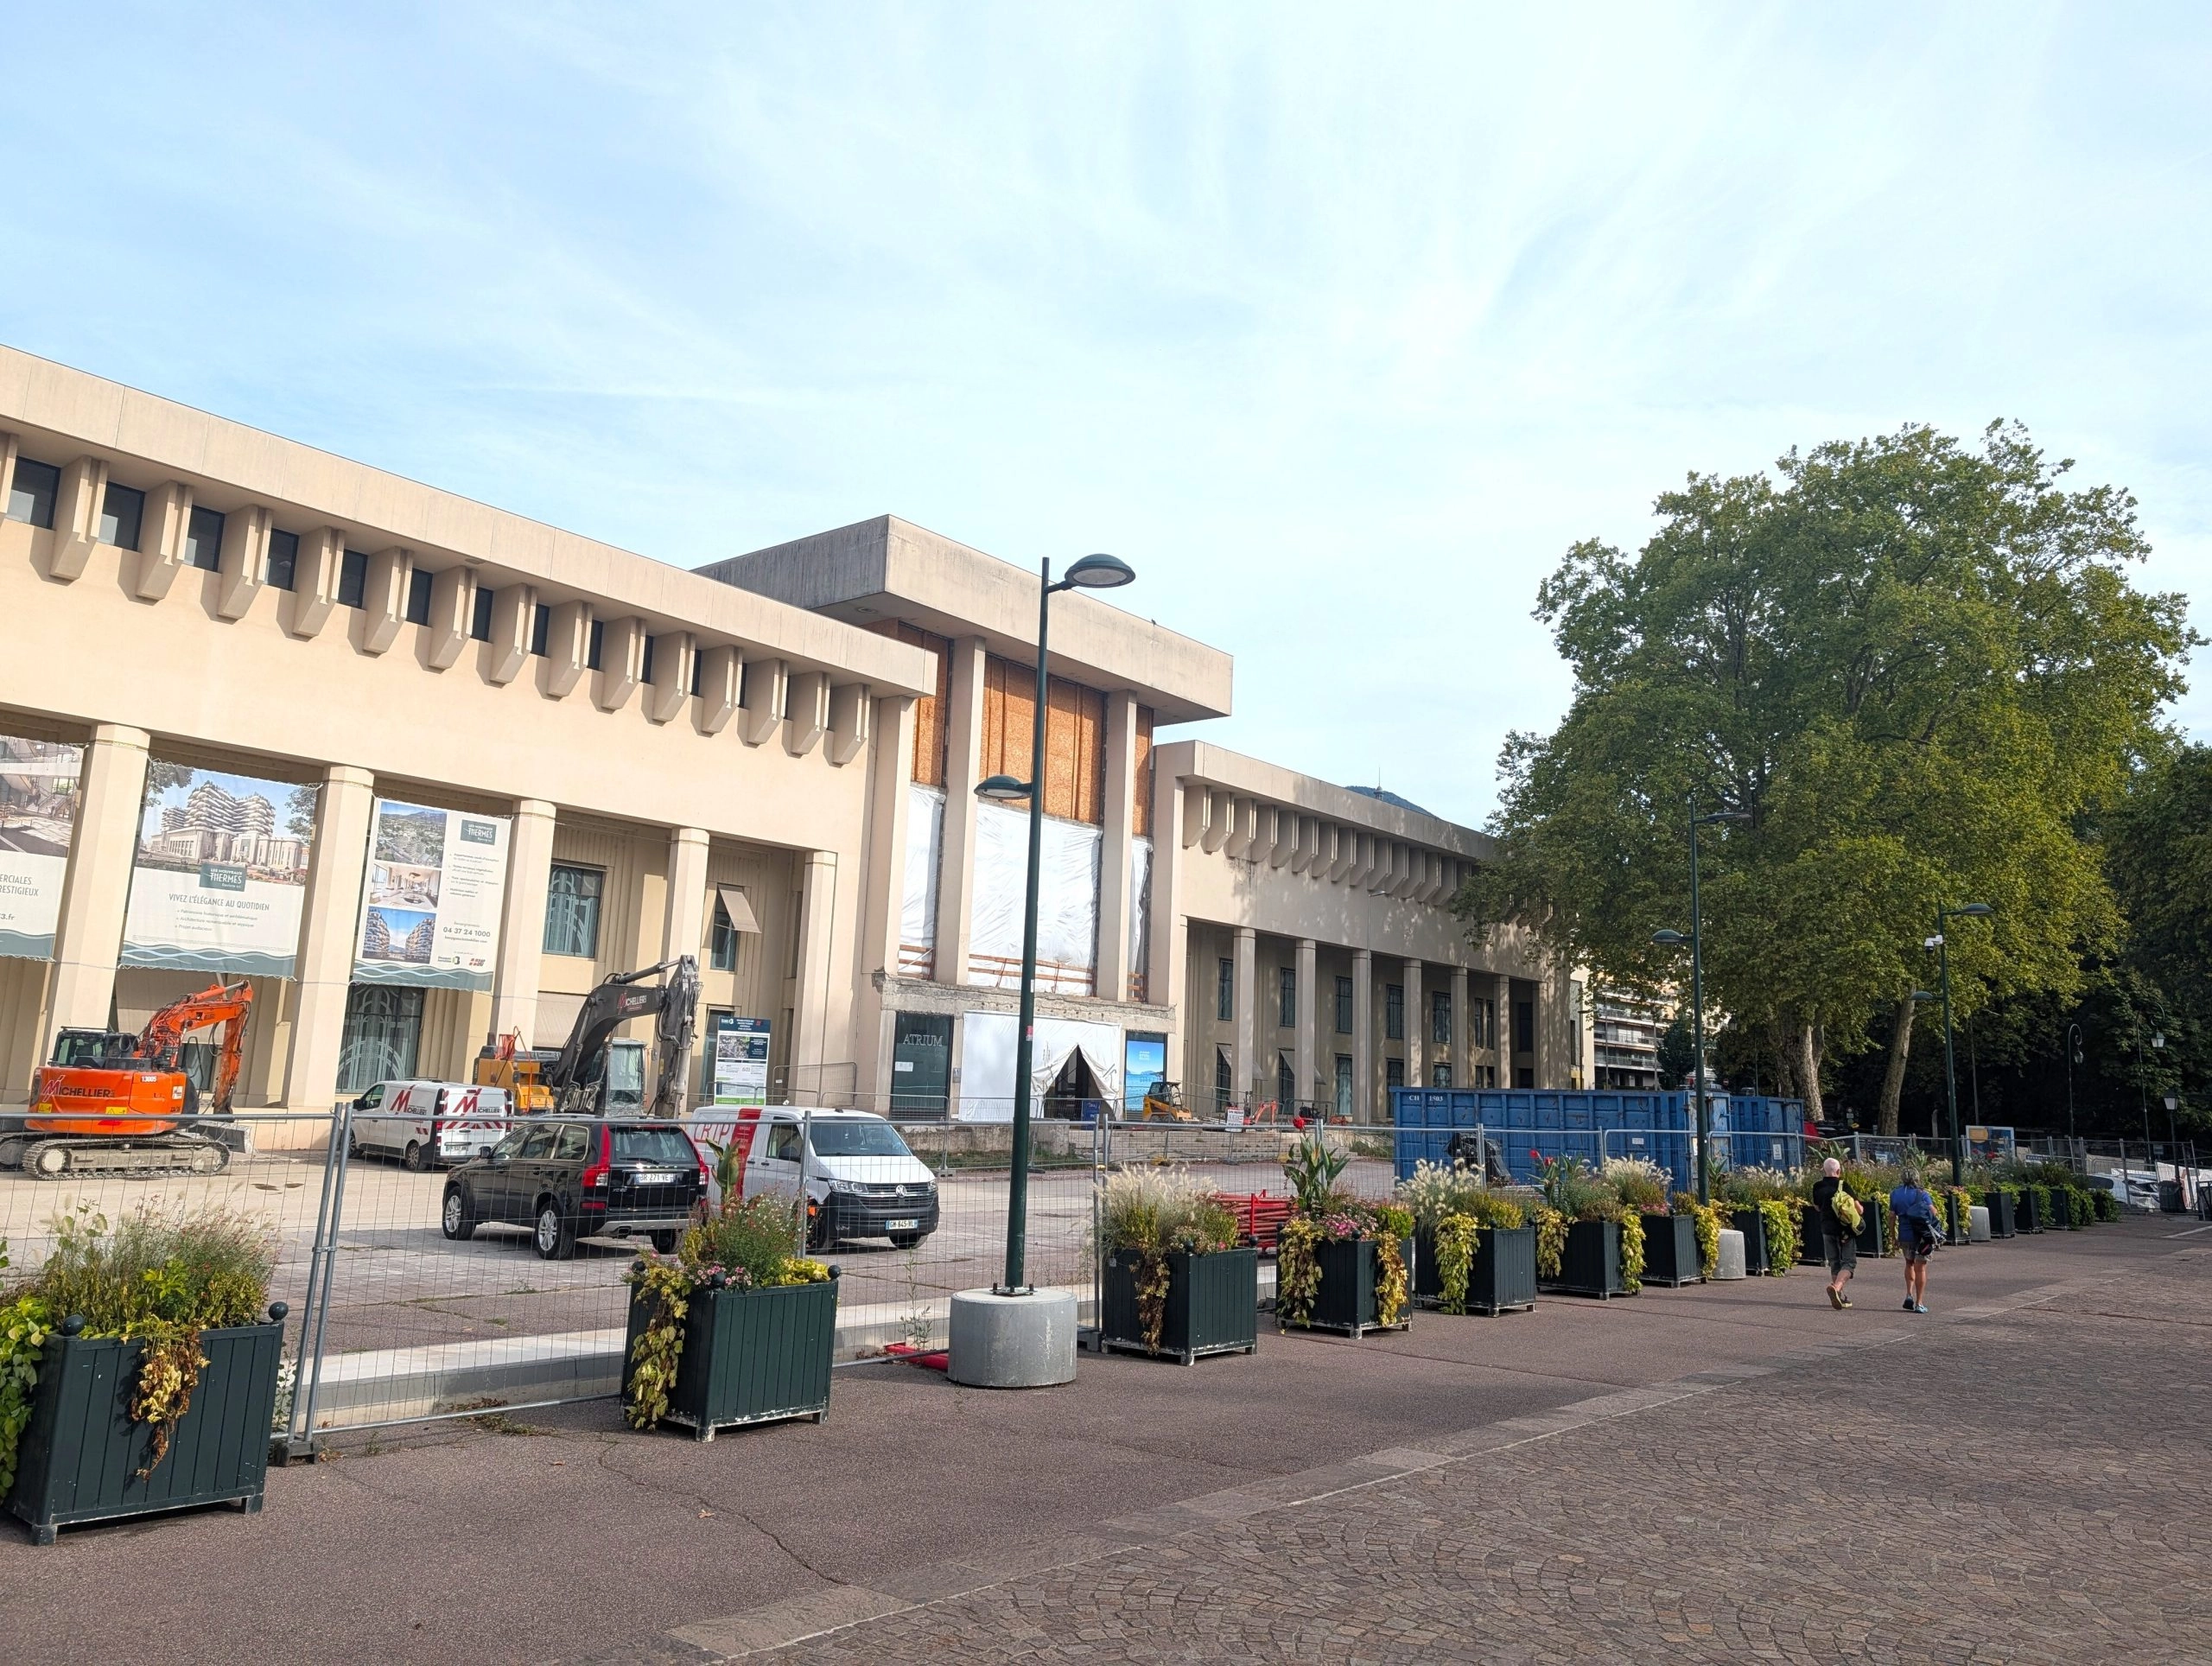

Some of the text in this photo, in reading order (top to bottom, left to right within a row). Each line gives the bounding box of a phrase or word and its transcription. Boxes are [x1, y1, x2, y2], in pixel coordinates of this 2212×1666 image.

[468, 827, 493, 839] THERMES
[210, 872, 243, 884] THERMES
[168, 893, 270, 911] VIVEZ L'ÉLÉGANCE AU QUOTIDIEN
[902, 1033, 944, 1047] ATRIUM
[41, 1074, 111, 1103] MICHELLIER
